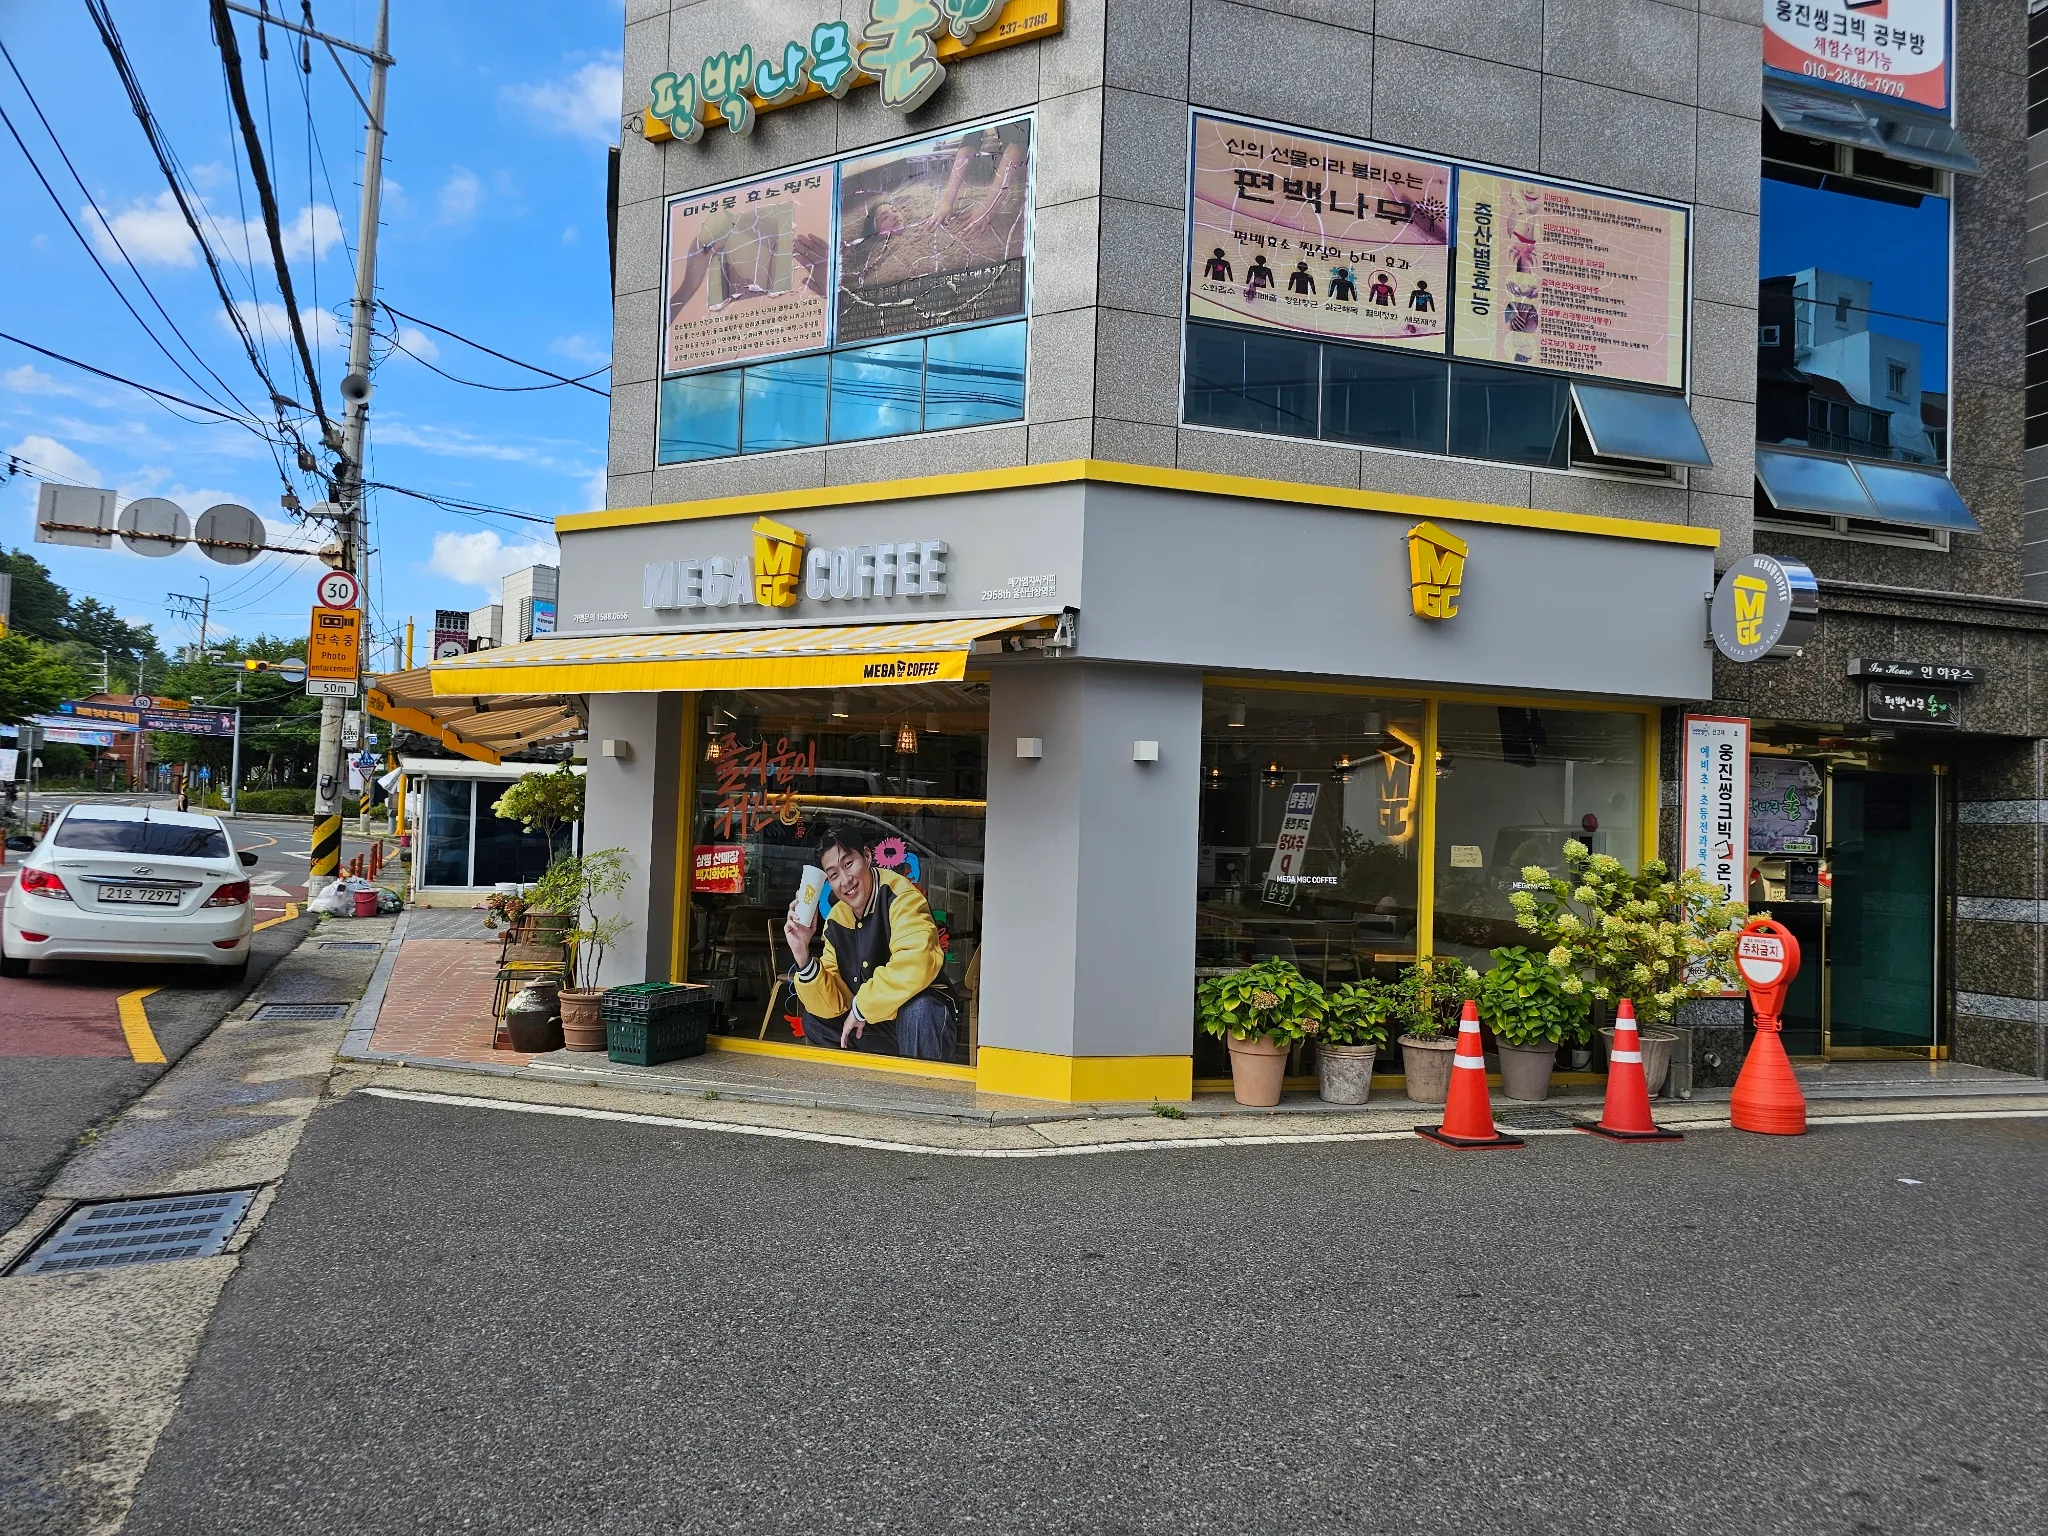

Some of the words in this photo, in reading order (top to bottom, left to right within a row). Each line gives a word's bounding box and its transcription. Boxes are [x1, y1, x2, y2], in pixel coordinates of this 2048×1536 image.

[999, 12, 1048, 36] 237-4788
[1776, 0, 1865, 41] 웅진씽크빅
[1874, 23, 1925, 55] 공부방
[1814, 37, 1892, 71] 체험수업가능
[651, 21, 853, 139] 편백나무
[1803, 60, 1905, 98] 010-2846-7979
[1225, 138, 1264, 159] 신의
[1270, 146, 1345, 175] 선물이라
[1351, 161, 1423, 190] 불리우는
[1233, 168, 1413, 225] 편백나무
[1233, 229, 1291, 250] 편백효소
[1299, 240, 1341, 262] 찜질의
[1385, 255, 1412, 270] 효과
[1404, 315, 1437, 327] 세포재생
[643, 556, 756, 610] MEGA
[806, 539, 951, 602] COFFEE
[327, 583, 348, 599] 30
[981, 588, 1011, 601] 2968th
[1773, 571, 1787, 602] COFFEE
[316, 633, 354, 647] 단속중
[321, 651, 346, 661] Photo
[311, 664, 355, 674] enforcement
[864, 663, 895, 678] MEGA
[907, 662, 940, 677] COFFEE
[1868, 662, 1884, 673] In
[1885, 664, 1914, 676] House
[1920, 666, 1932, 679] 인
[1937, 667, 1974, 680] 하우스
[323, 682, 347, 694] 50m
[1884, 695, 1925, 712] 편백나무
[1717, 743, 1733, 840] 웅진씽크빅
[1749, 797, 1780, 818] 백나무
[1276, 875, 1296, 884] MEGA
[1296, 875, 1311, 884] MGC
[1311, 876, 1338, 885] COFFEE
[106, 887, 133, 899] 21오
[139, 889, 173, 902] 7297
[1743, 943, 1778, 957] 주차금지
